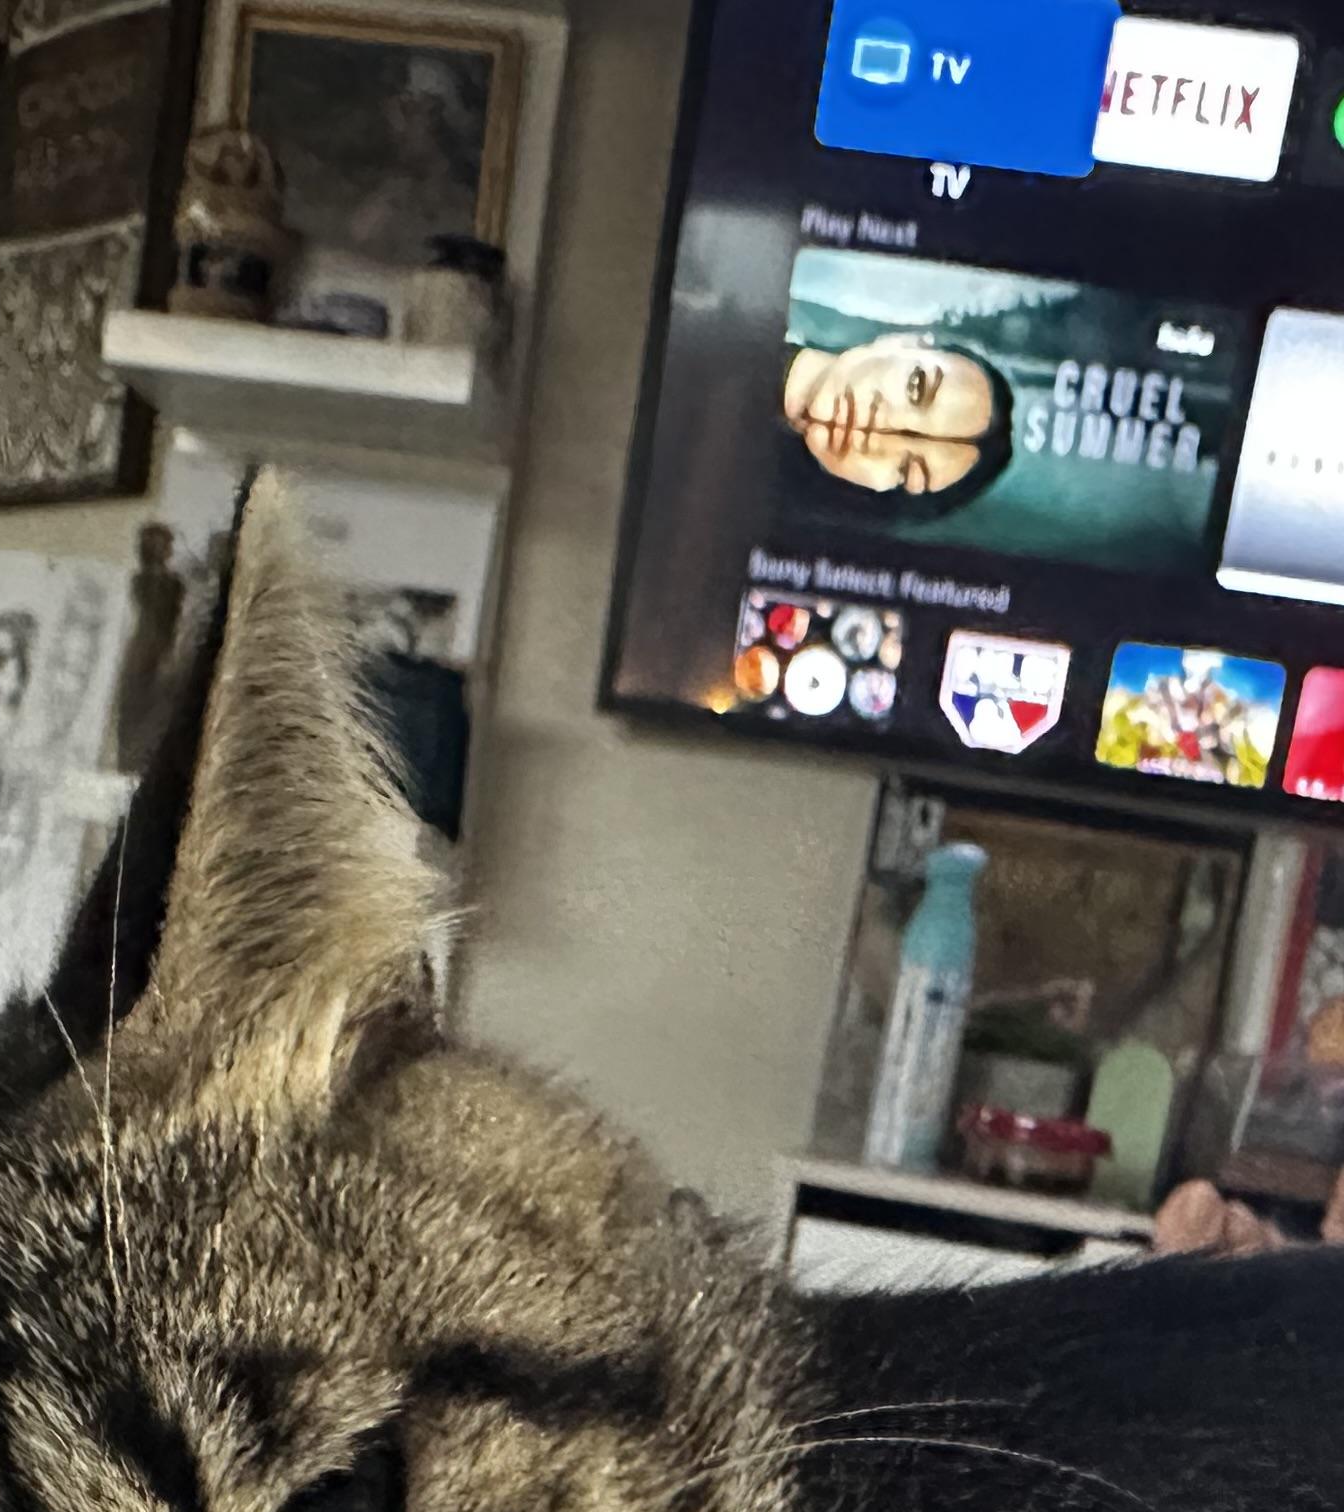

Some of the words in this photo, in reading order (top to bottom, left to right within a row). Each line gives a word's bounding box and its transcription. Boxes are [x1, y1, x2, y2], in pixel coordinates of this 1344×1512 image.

[932, 52, 972, 84] TV
[930, 162, 971, 199] TV
[857, 210, 918, 248] Next
[1054, 359, 1186, 425] CRUEL
[1023, 404, 1202, 473] SUMMER
[748, 549, 811, 590] Sony
